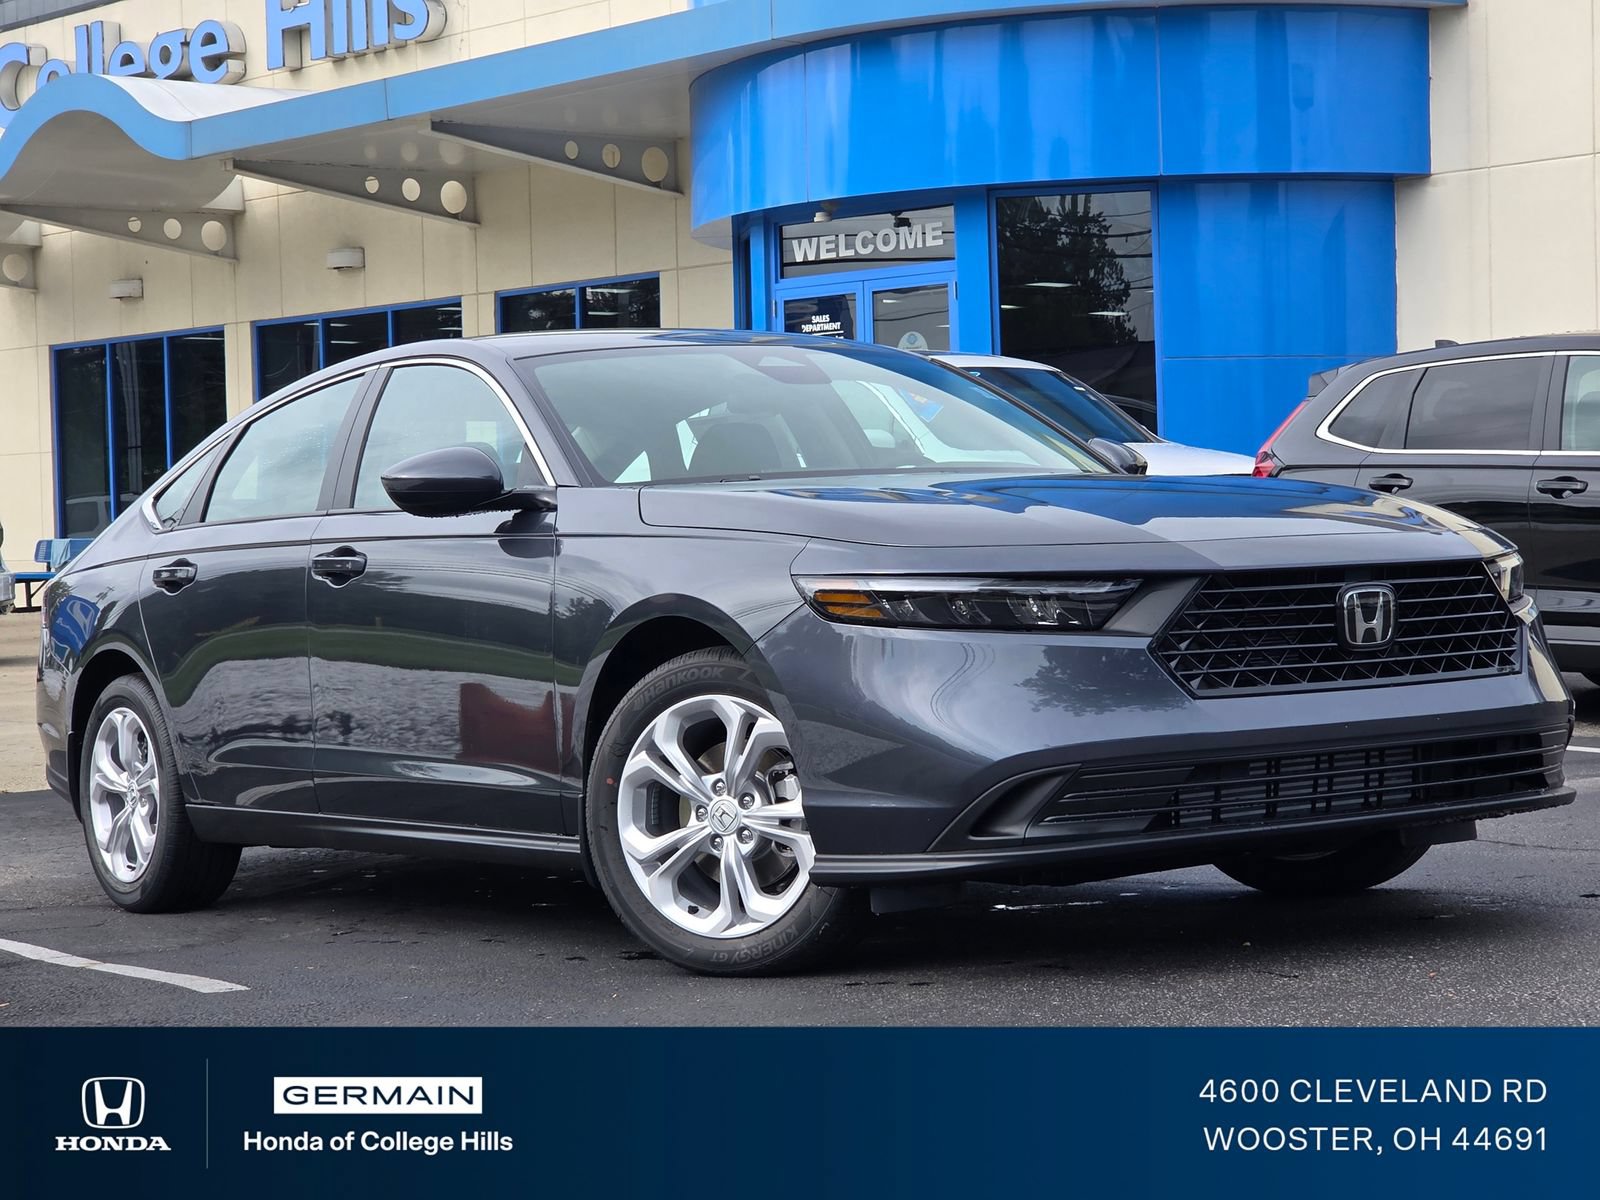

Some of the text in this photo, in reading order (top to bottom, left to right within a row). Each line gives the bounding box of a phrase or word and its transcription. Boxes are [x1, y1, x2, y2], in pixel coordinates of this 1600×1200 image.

[266, 0, 429, 71] Hills
[792, 221, 944, 263] WELCOME
[802, 322, 841, 333] DEPARTMENT
[811, 315, 830, 323] SALES
